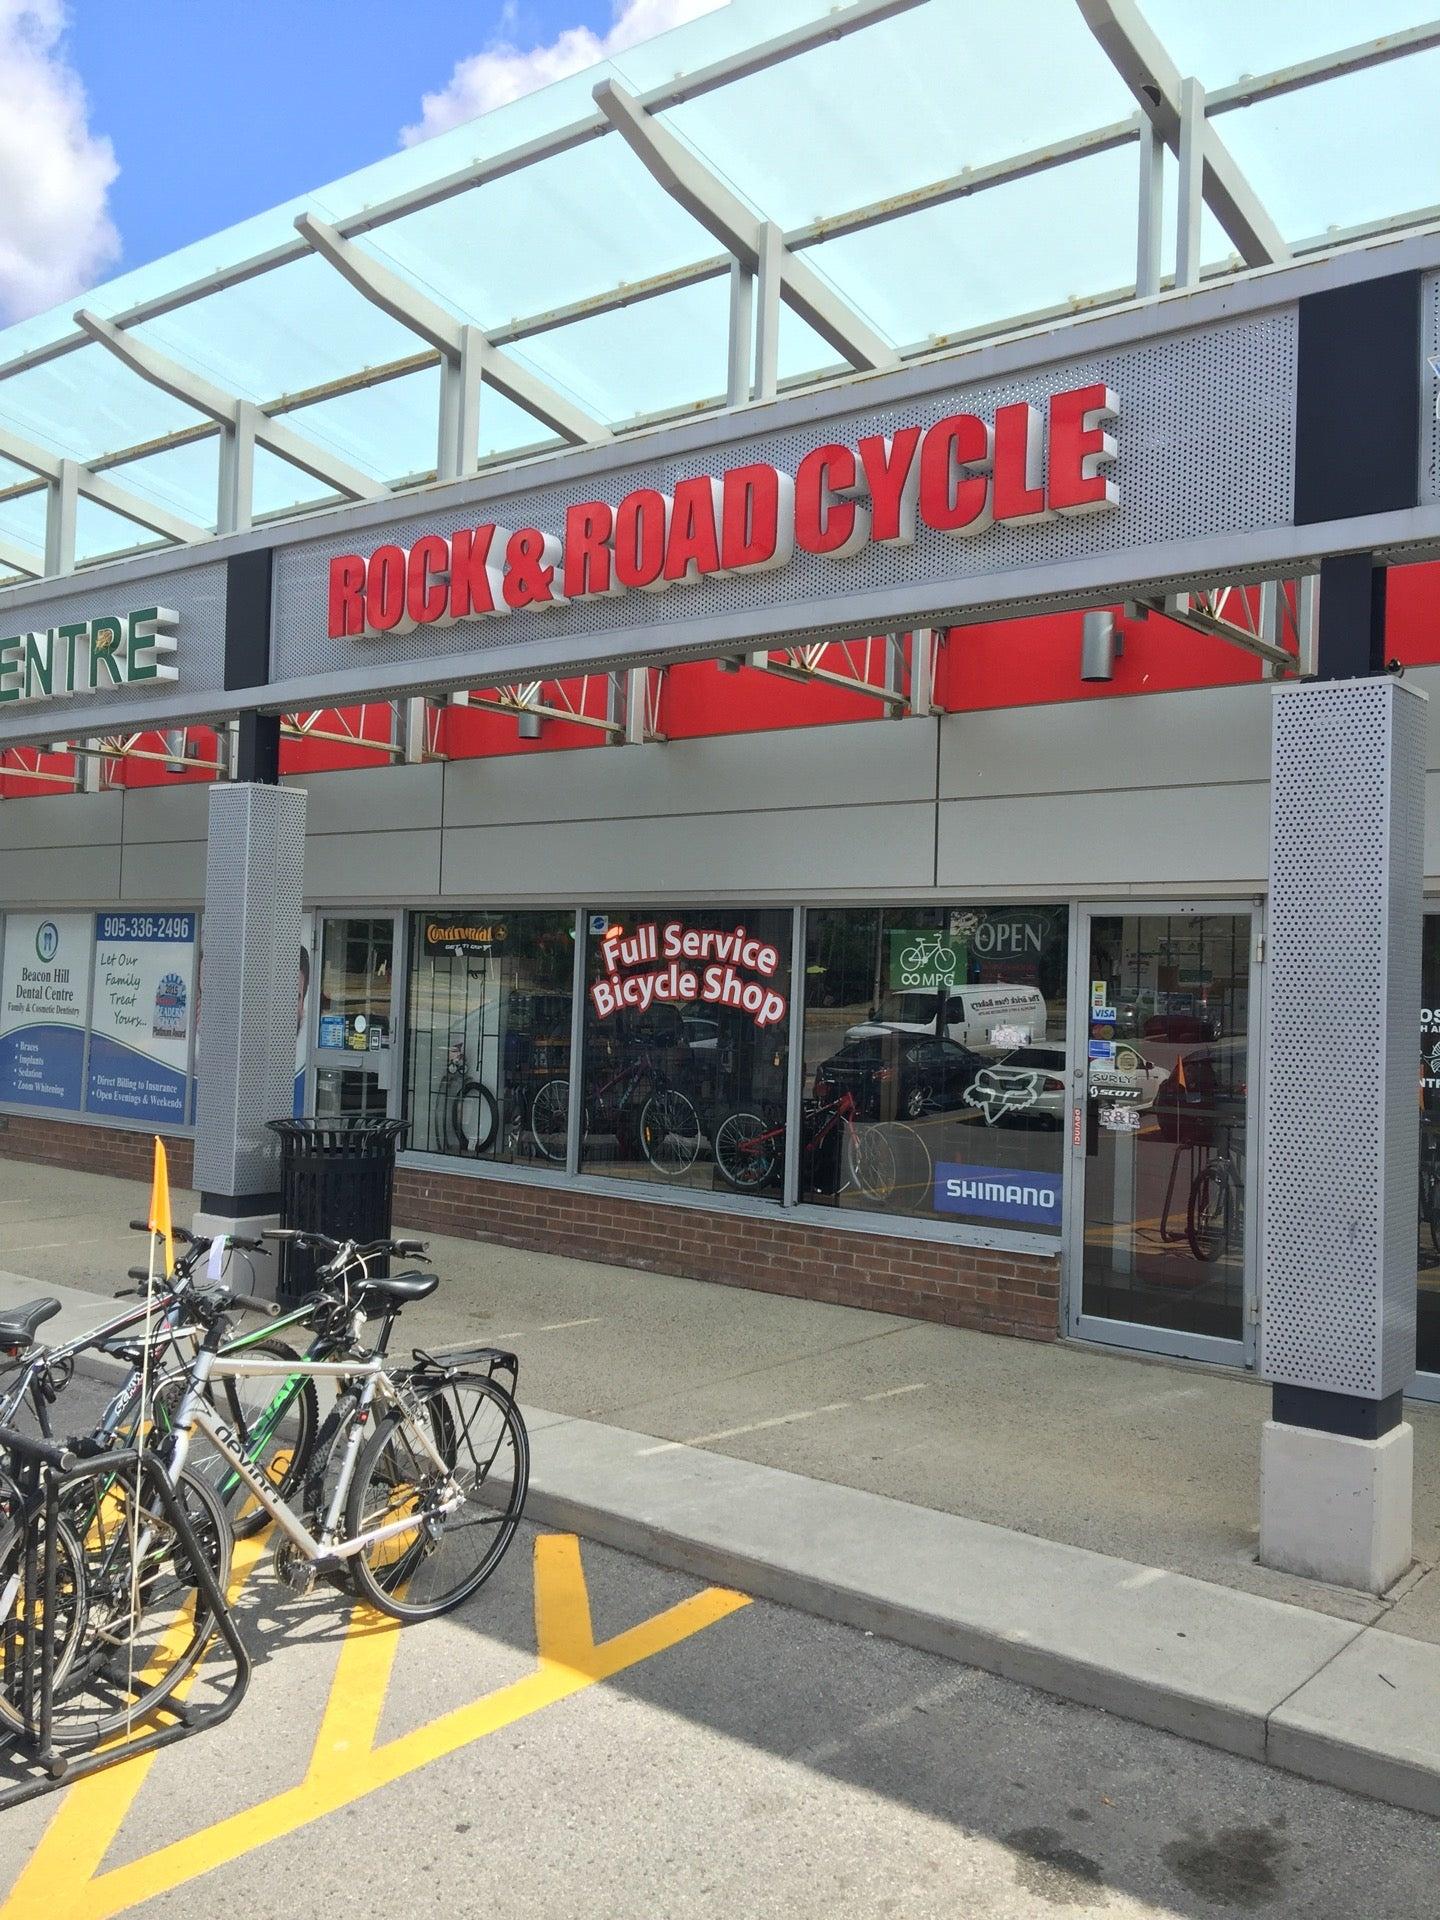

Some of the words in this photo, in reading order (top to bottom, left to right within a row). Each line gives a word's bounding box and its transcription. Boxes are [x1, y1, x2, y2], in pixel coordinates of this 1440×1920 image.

[328, 523, 507, 640] ROCK
[503, 527, 562, 610] &
[563, 462, 785, 599] ROAD
[794, 383, 1115, 557] CYCLE
[104, 917, 189, 939] 905-336-2496
[975, 923, 1042, 952] OPEN
[602, 923, 658, 972] Full
[664, 922, 779, 975] Service
[100, 953, 117, 966] Let
[118, 953, 138, 967] Our
[22, 968, 51, 983] Beacon
[53, 969, 70, 984] Hill
[105, 973, 141, 990] Family
[922, 972, 955, 987] MPG
[16, 984, 43, 1000] Dental
[45, 985, 74, 1002] Centre
[109, 992, 137, 1007] Treat
[592, 962, 698, 1018] Bicycle
[703, 965, 785, 1026] Shop
[1095, 1009, 1115, 1018] VISA
[117, 1077, 137, 1091] Billing
[138, 1081, 145, 1090] to
[146, 1080, 178, 1094] Insurance
[1093, 1073, 1133, 1084] SURLY
[96, 1089, 112, 1102] Open
[113, 1091, 142, 1106] Evenings
[150, 1096, 182, 1109] Weekends
[1099, 1089, 1141, 1098] SCOTT
[946, 1178, 1055, 1208] SHIMANO
